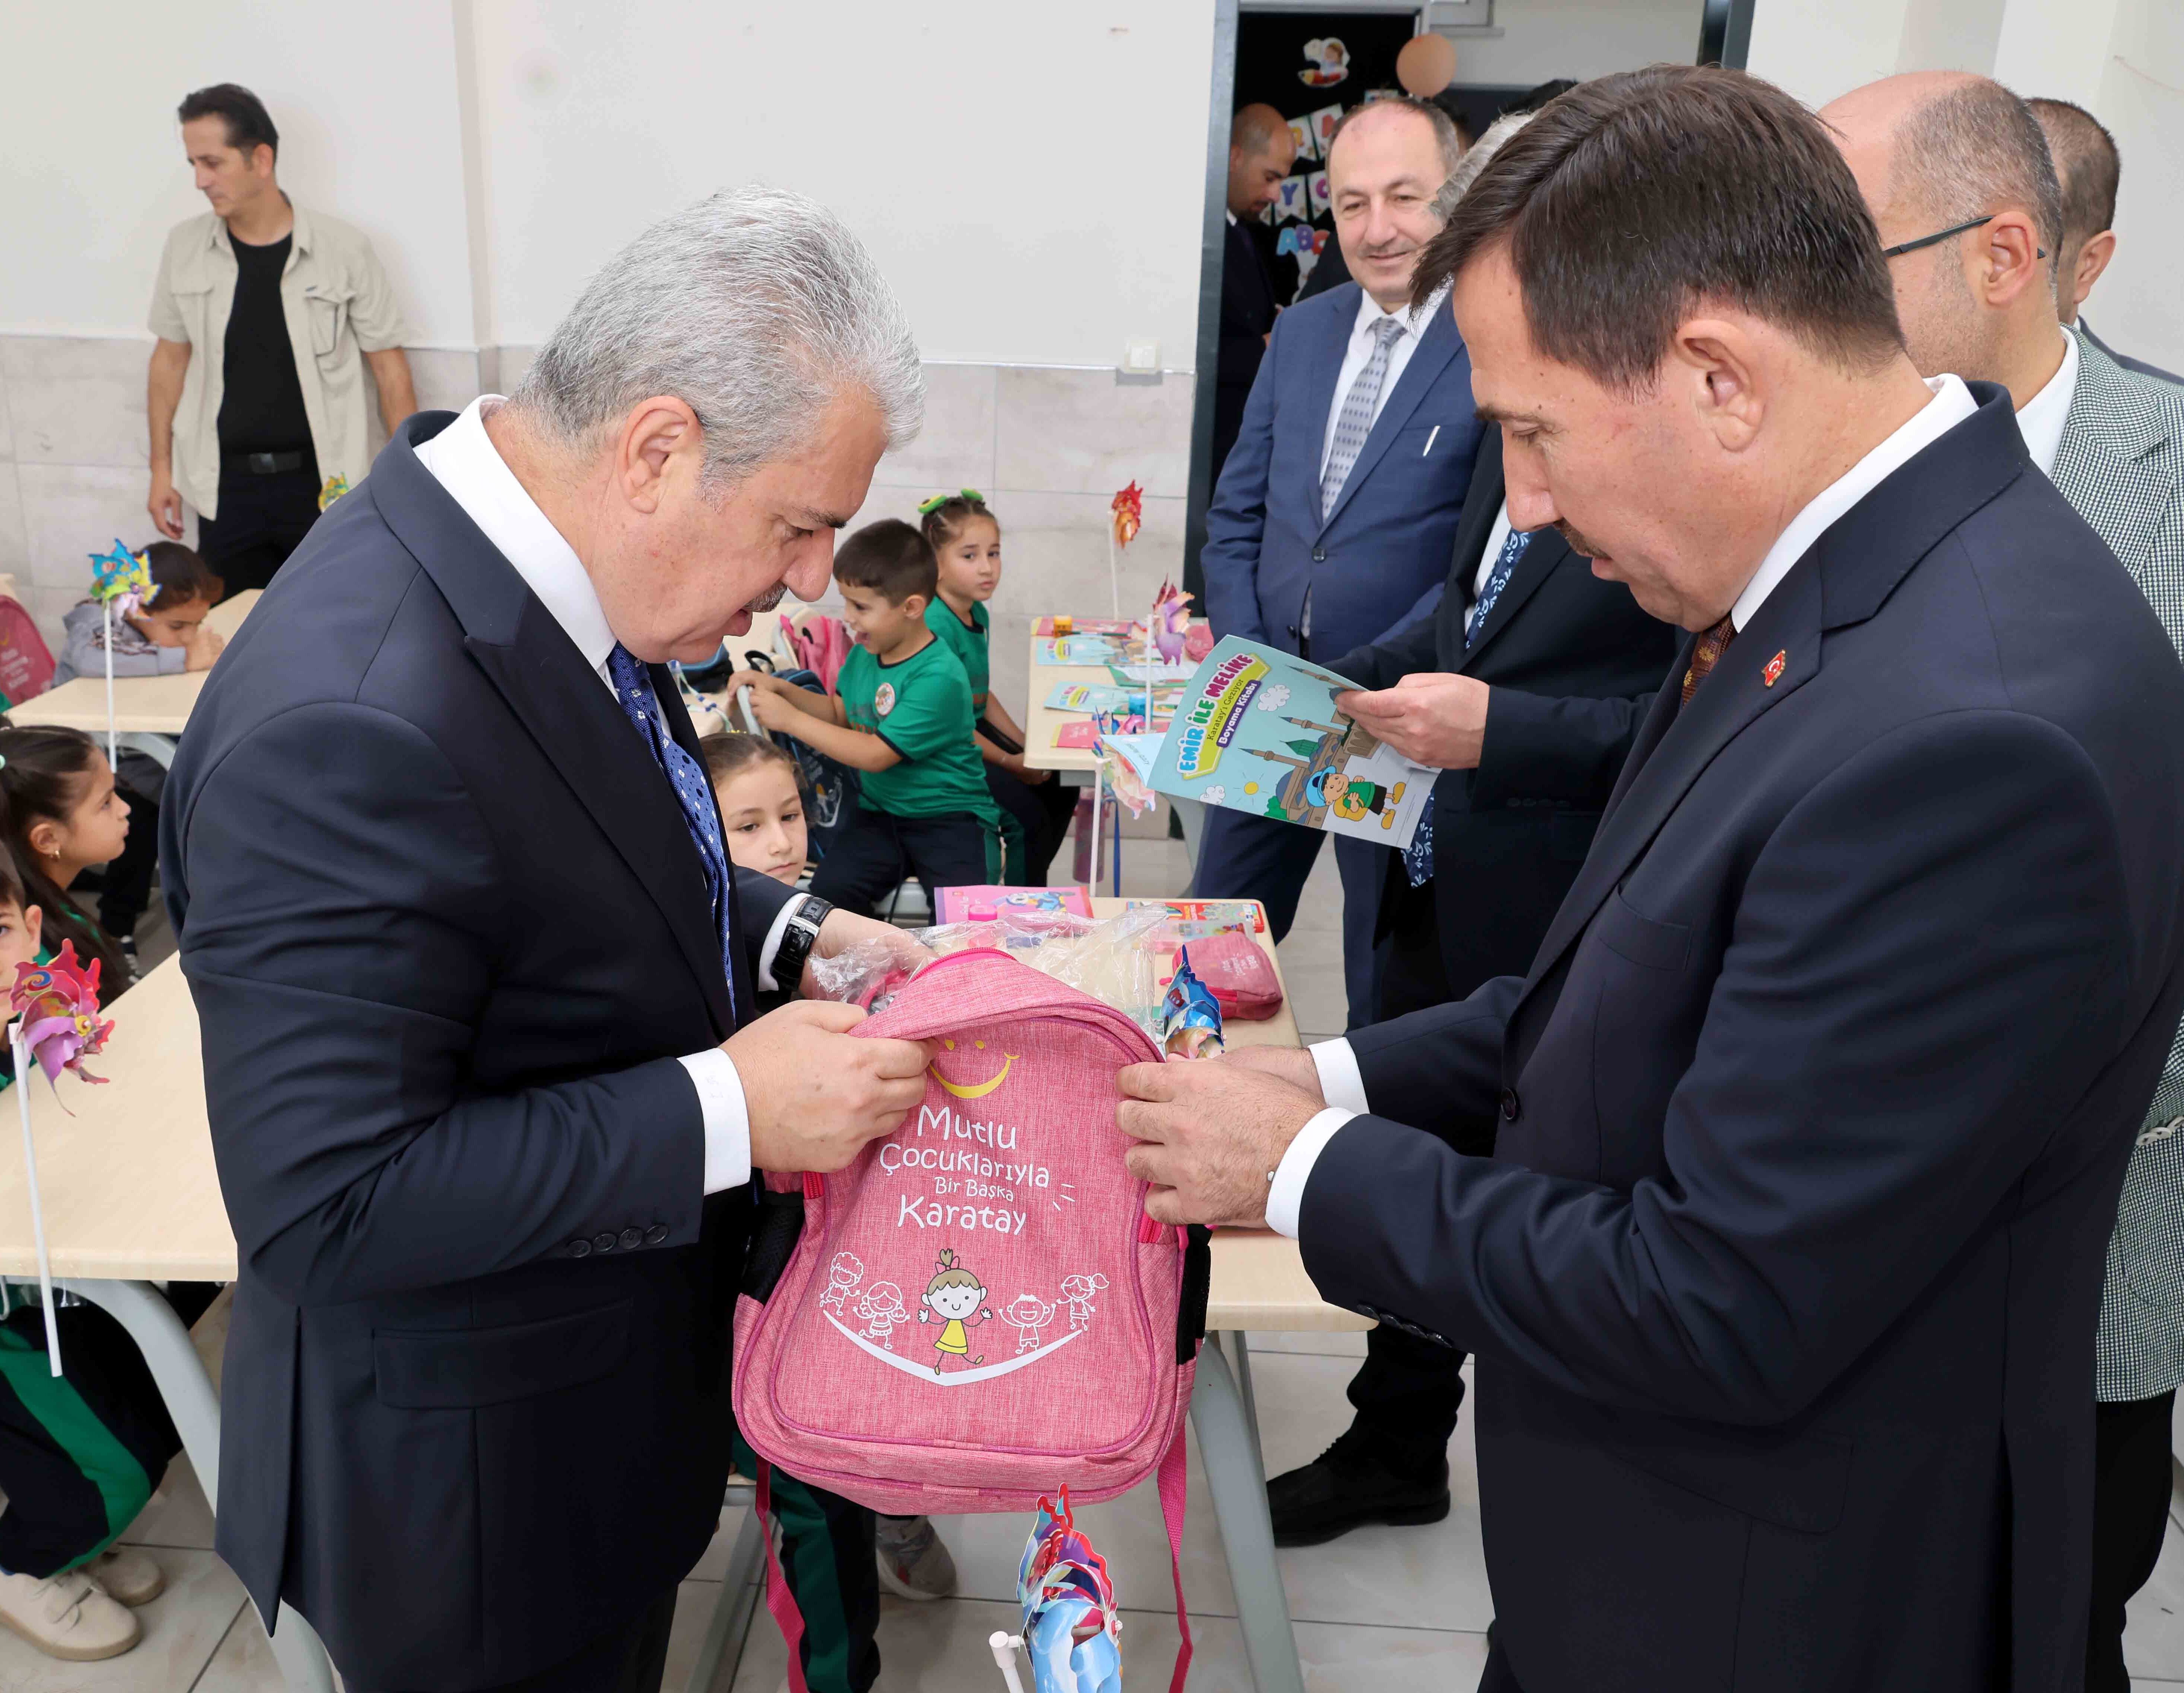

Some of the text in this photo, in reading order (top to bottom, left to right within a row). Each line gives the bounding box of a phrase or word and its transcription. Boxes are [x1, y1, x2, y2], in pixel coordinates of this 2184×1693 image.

[1179, 654, 1253, 771] EMİR İLE MELİKE
[1219, 683, 1257, 744] Boyama Kitabı
[1224, 679, 1244, 705] Geziyor
[917, 1105, 1017, 1150] Mutlu
[880, 1143, 1050, 1188] Çocuklarıyla
[933, 1176, 1014, 1202] Bir Başka
[897, 1194, 1027, 1236] Karatay
